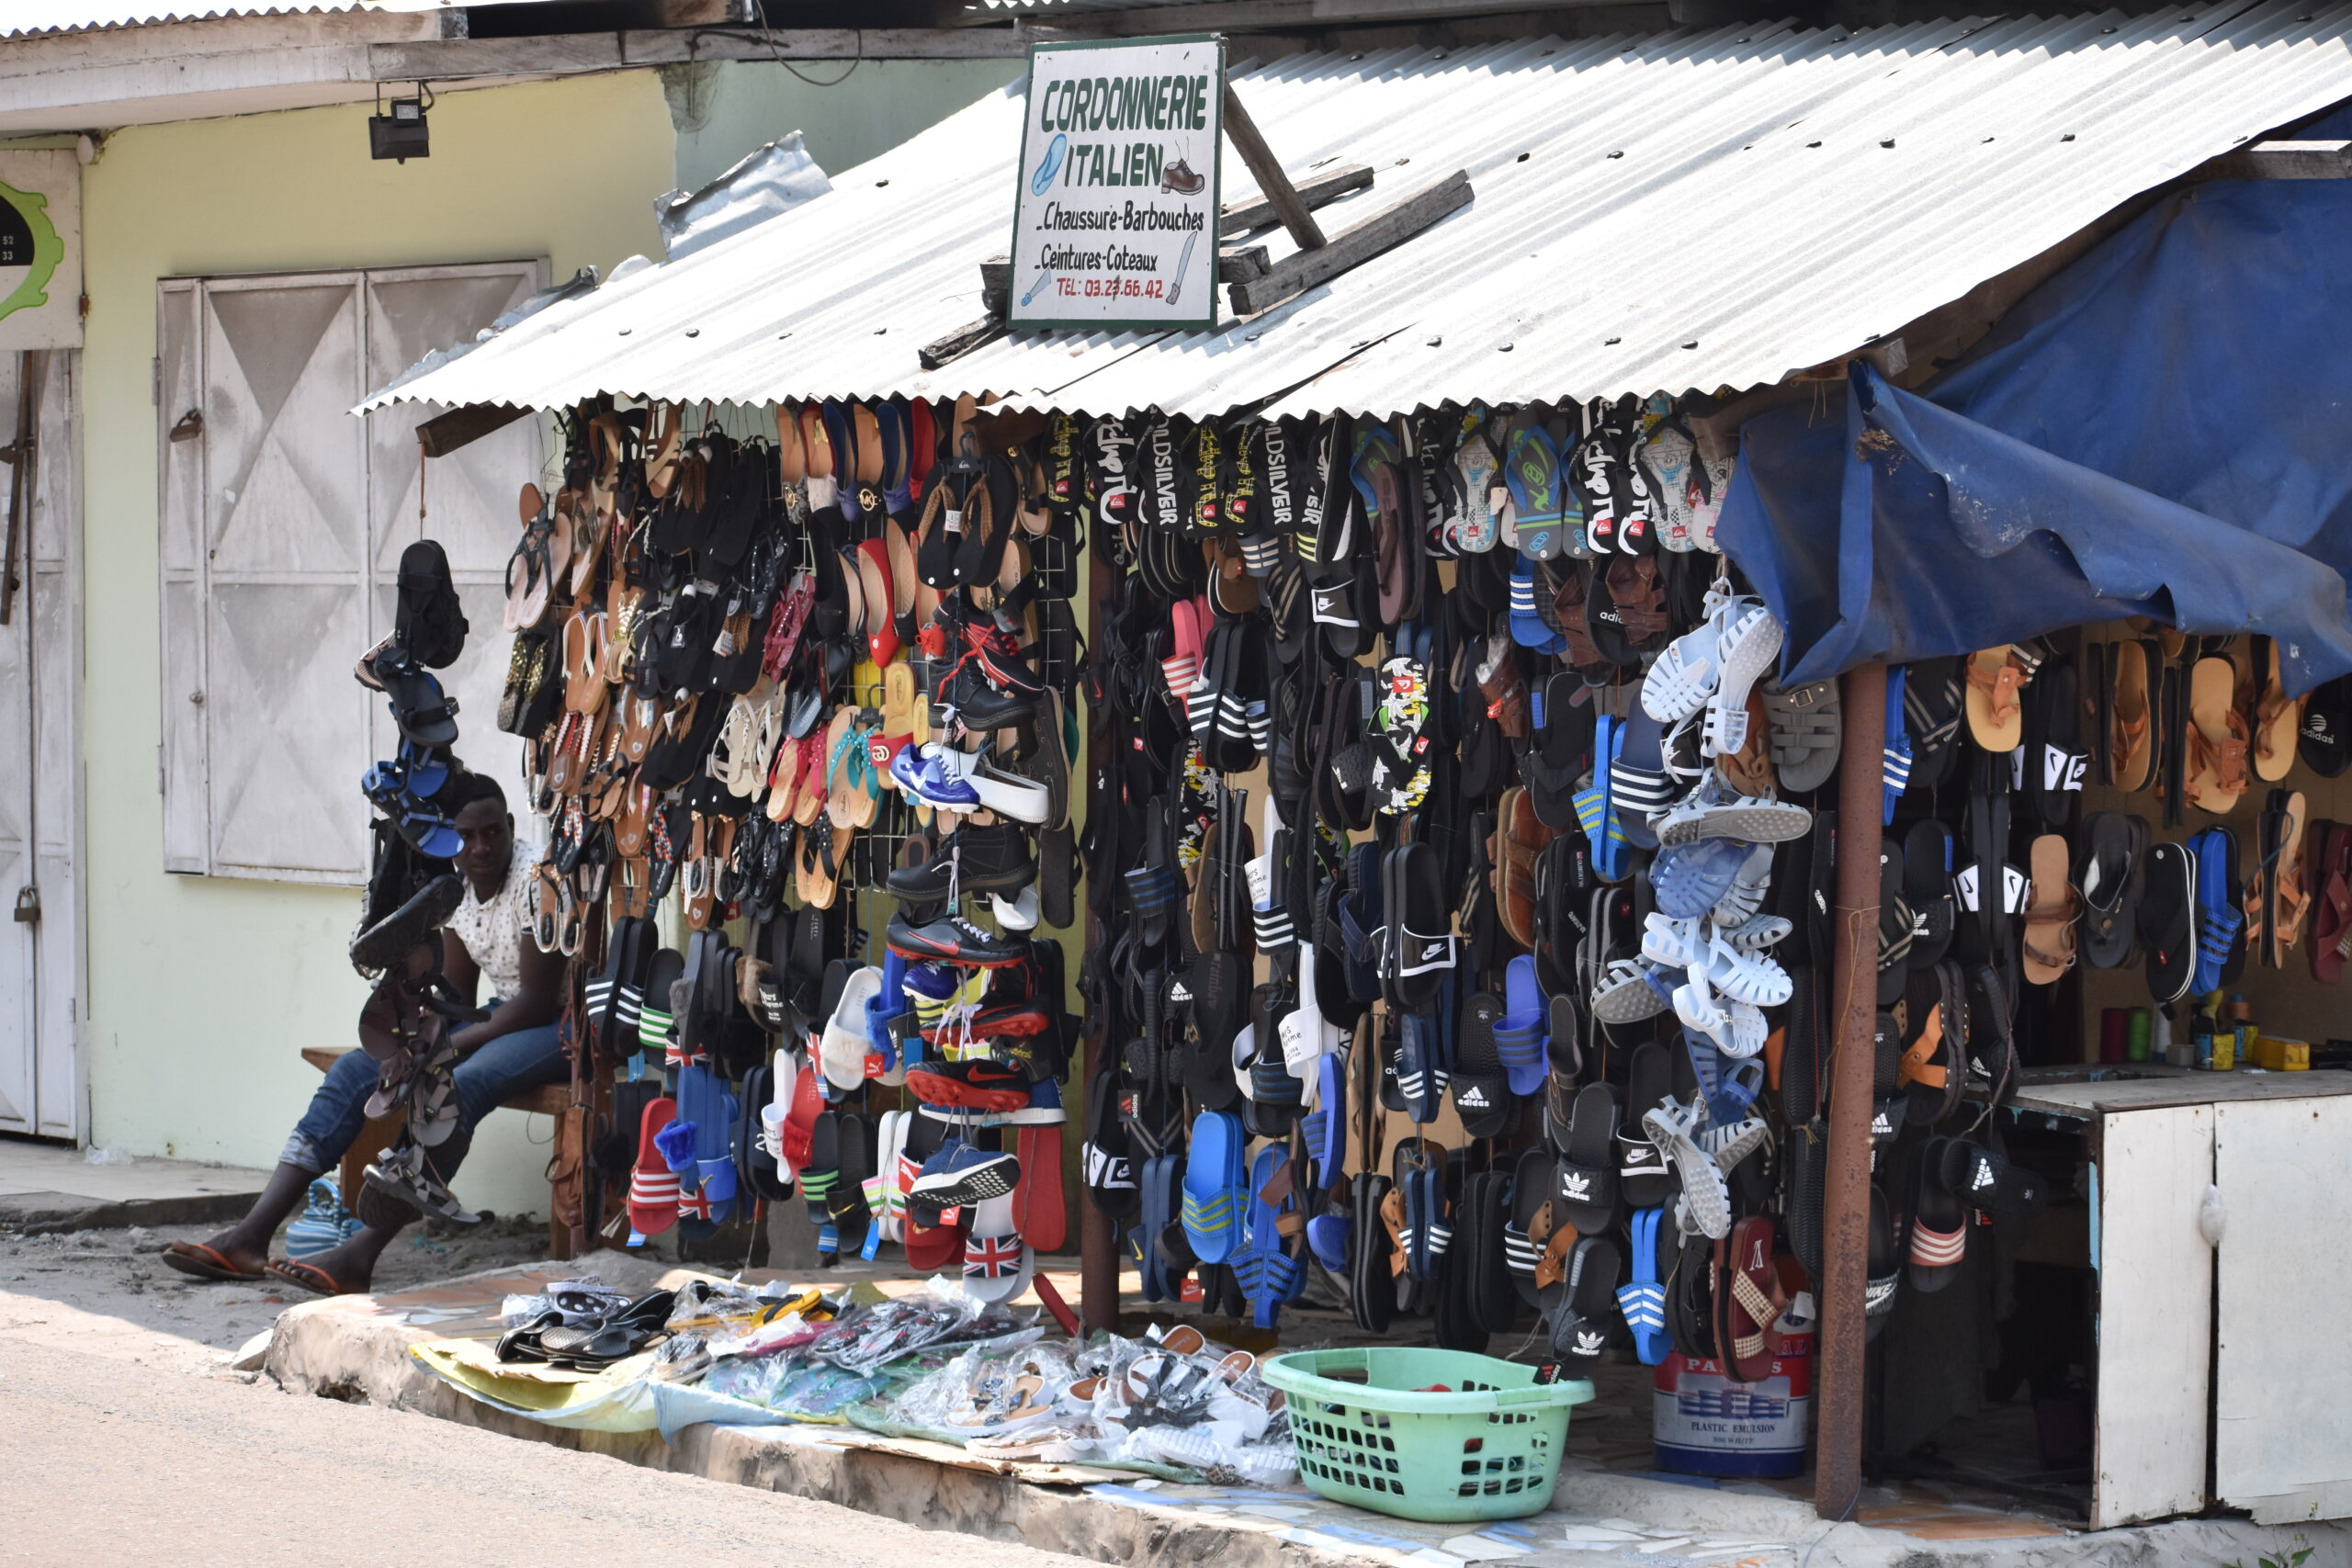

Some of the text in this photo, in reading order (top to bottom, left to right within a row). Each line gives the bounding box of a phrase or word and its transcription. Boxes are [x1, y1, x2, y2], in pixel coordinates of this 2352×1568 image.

[1040, 74, 1208, 133] CORDONNERIE
[1064, 142, 1164, 187] ITALIEN
[3, 235, 14, 245] 52
[2, 251, 13, 261] 33
[1057, 277, 1080, 297] TEL:
[2301, 728, 2335, 744] adidas
[1207, 961, 1222, 1010] rainbow
[1457, 1098, 1490, 1107] adidas
[1630, 1148, 1647, 1157] NIKE
[1562, 1189, 1590, 1201] adidas
[1687, 1358, 1782, 1374] PAS
[1691, 1421, 1775, 1434] PLASTIC EMULSION
